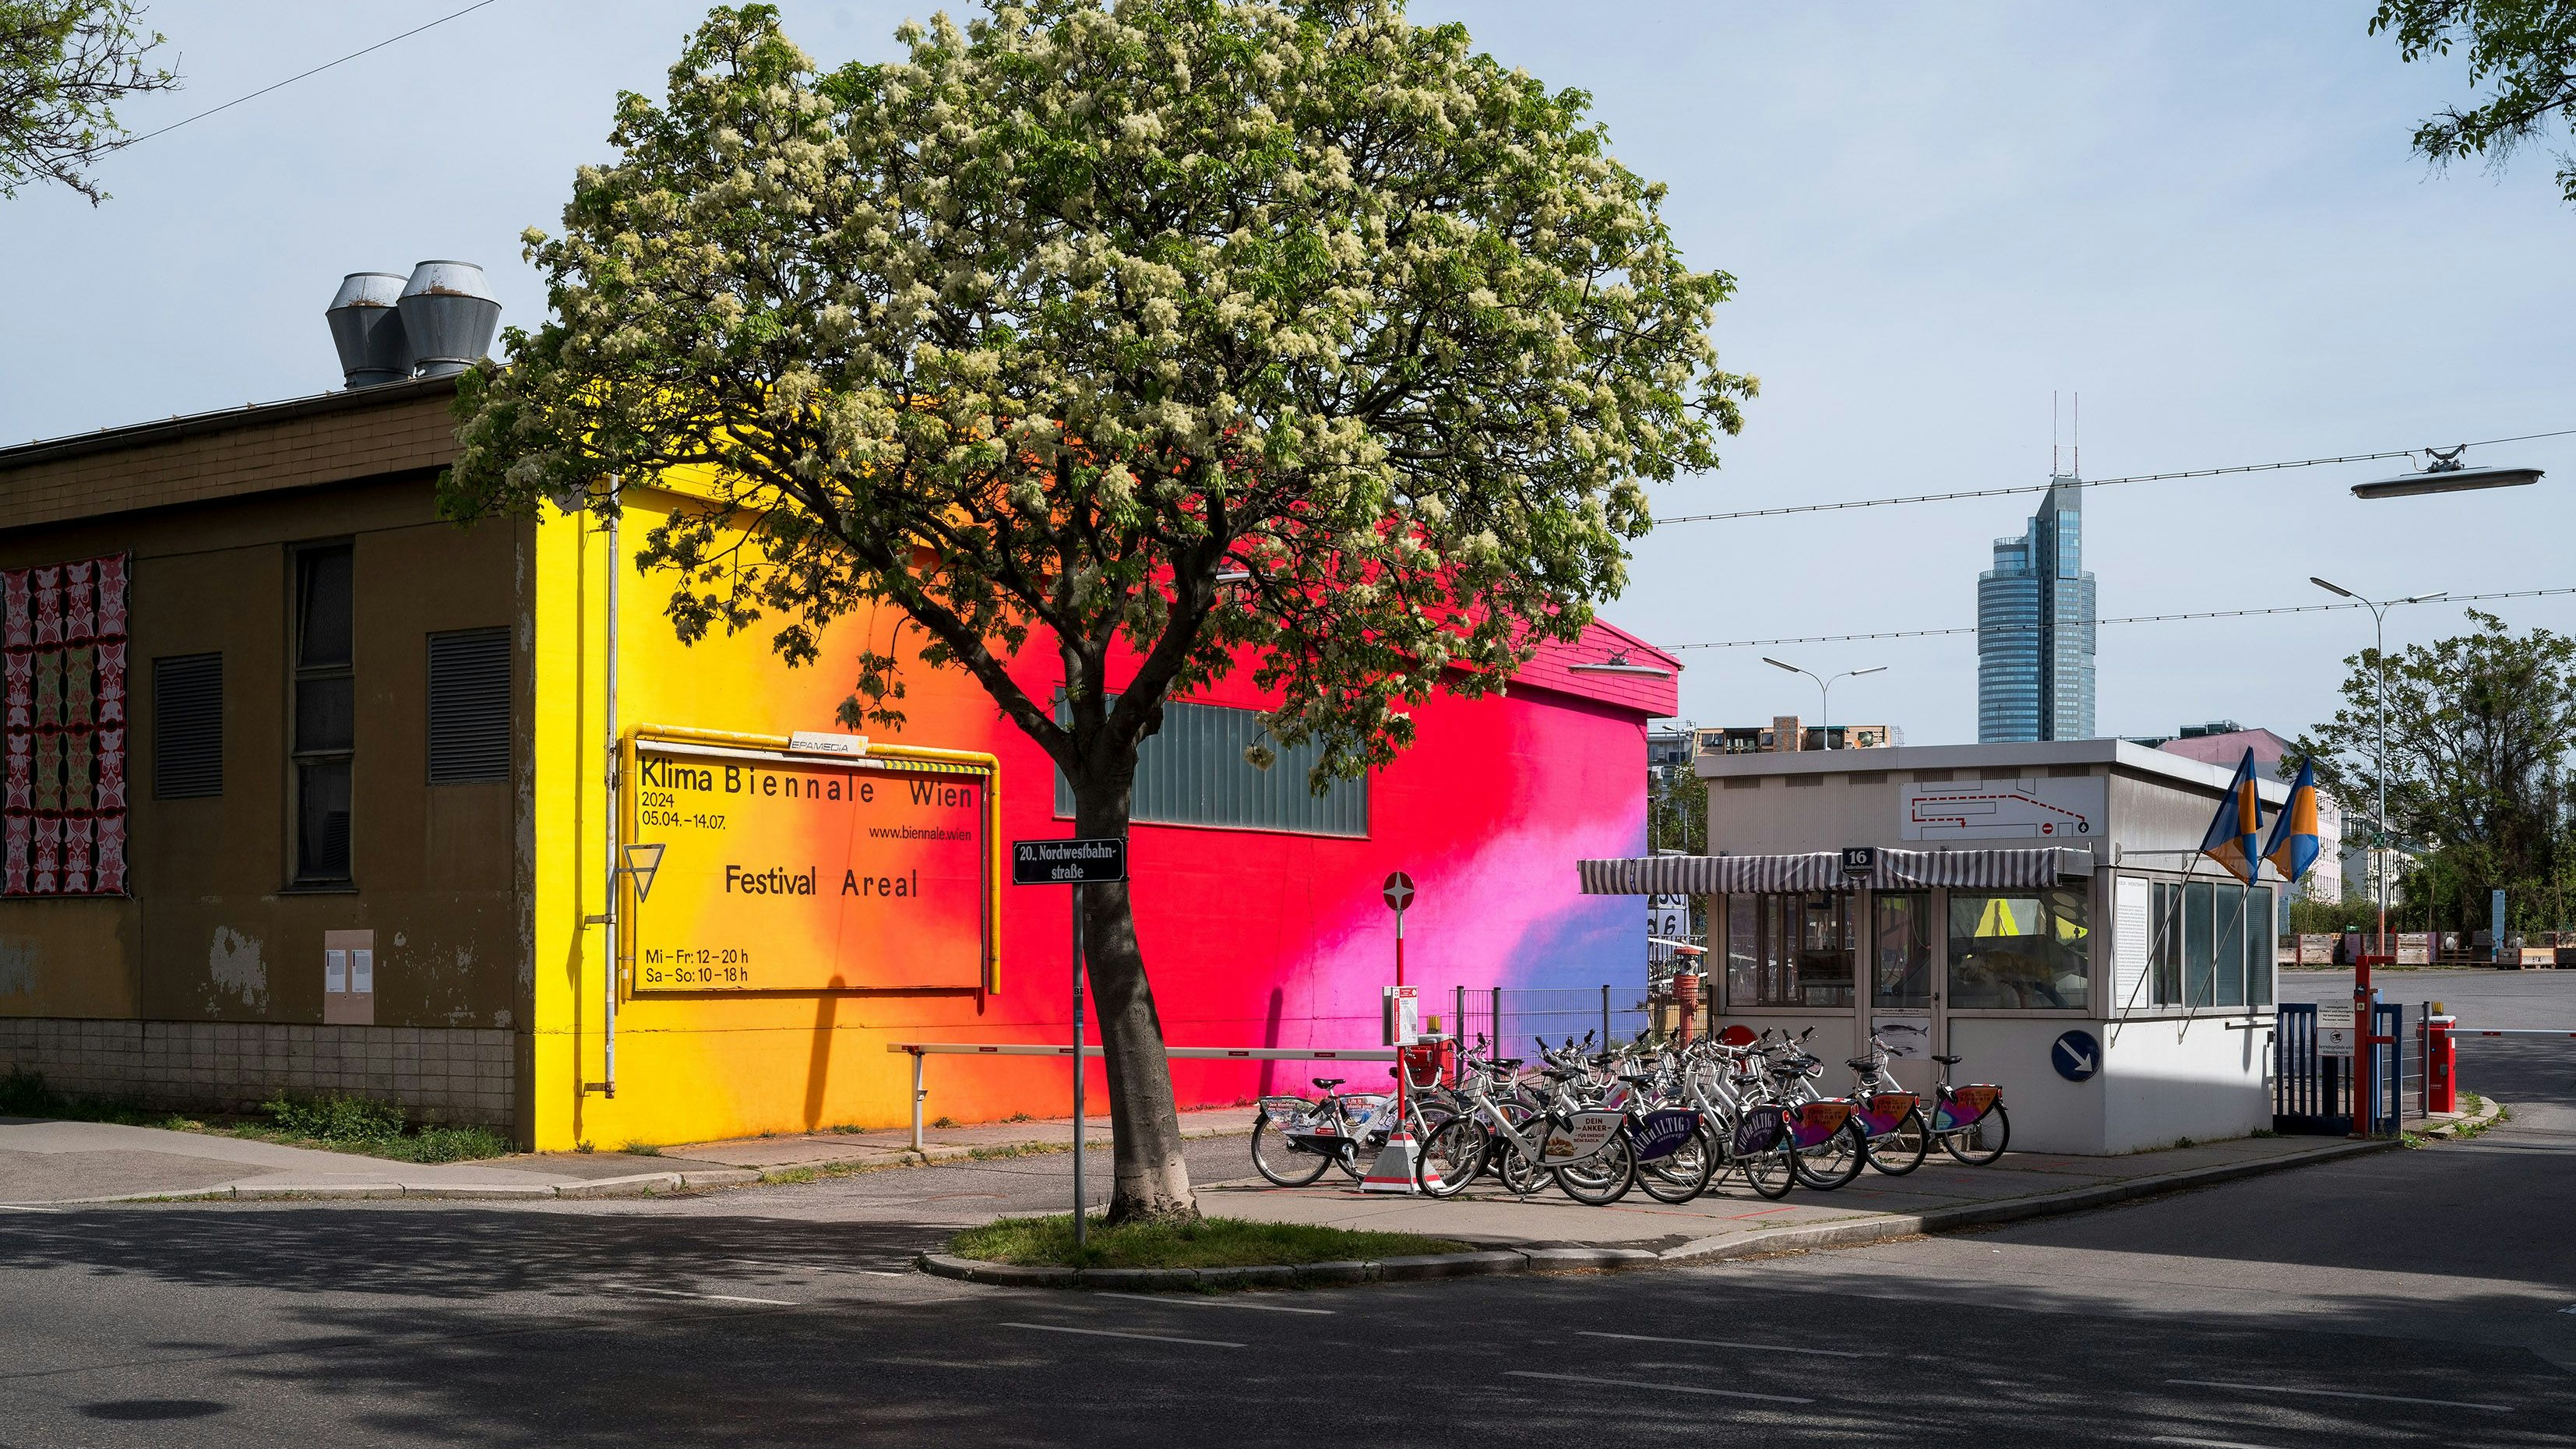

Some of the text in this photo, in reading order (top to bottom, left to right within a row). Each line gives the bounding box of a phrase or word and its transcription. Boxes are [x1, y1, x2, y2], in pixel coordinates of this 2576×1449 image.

[642, 756, 971, 808] Klima Biennale Wien
[642, 791, 675, 808] 2024
[869, 825, 971, 841] www.biennale.wien
[1039, 842, 1116, 861] Nordwestbahn-
[1849, 851, 1867, 864] 16
[1051, 863, 1084, 880] straße
[726, 865, 917, 897] Festival Areal
[742, 949, 749, 964] h
[741, 967, 748, 982] h
